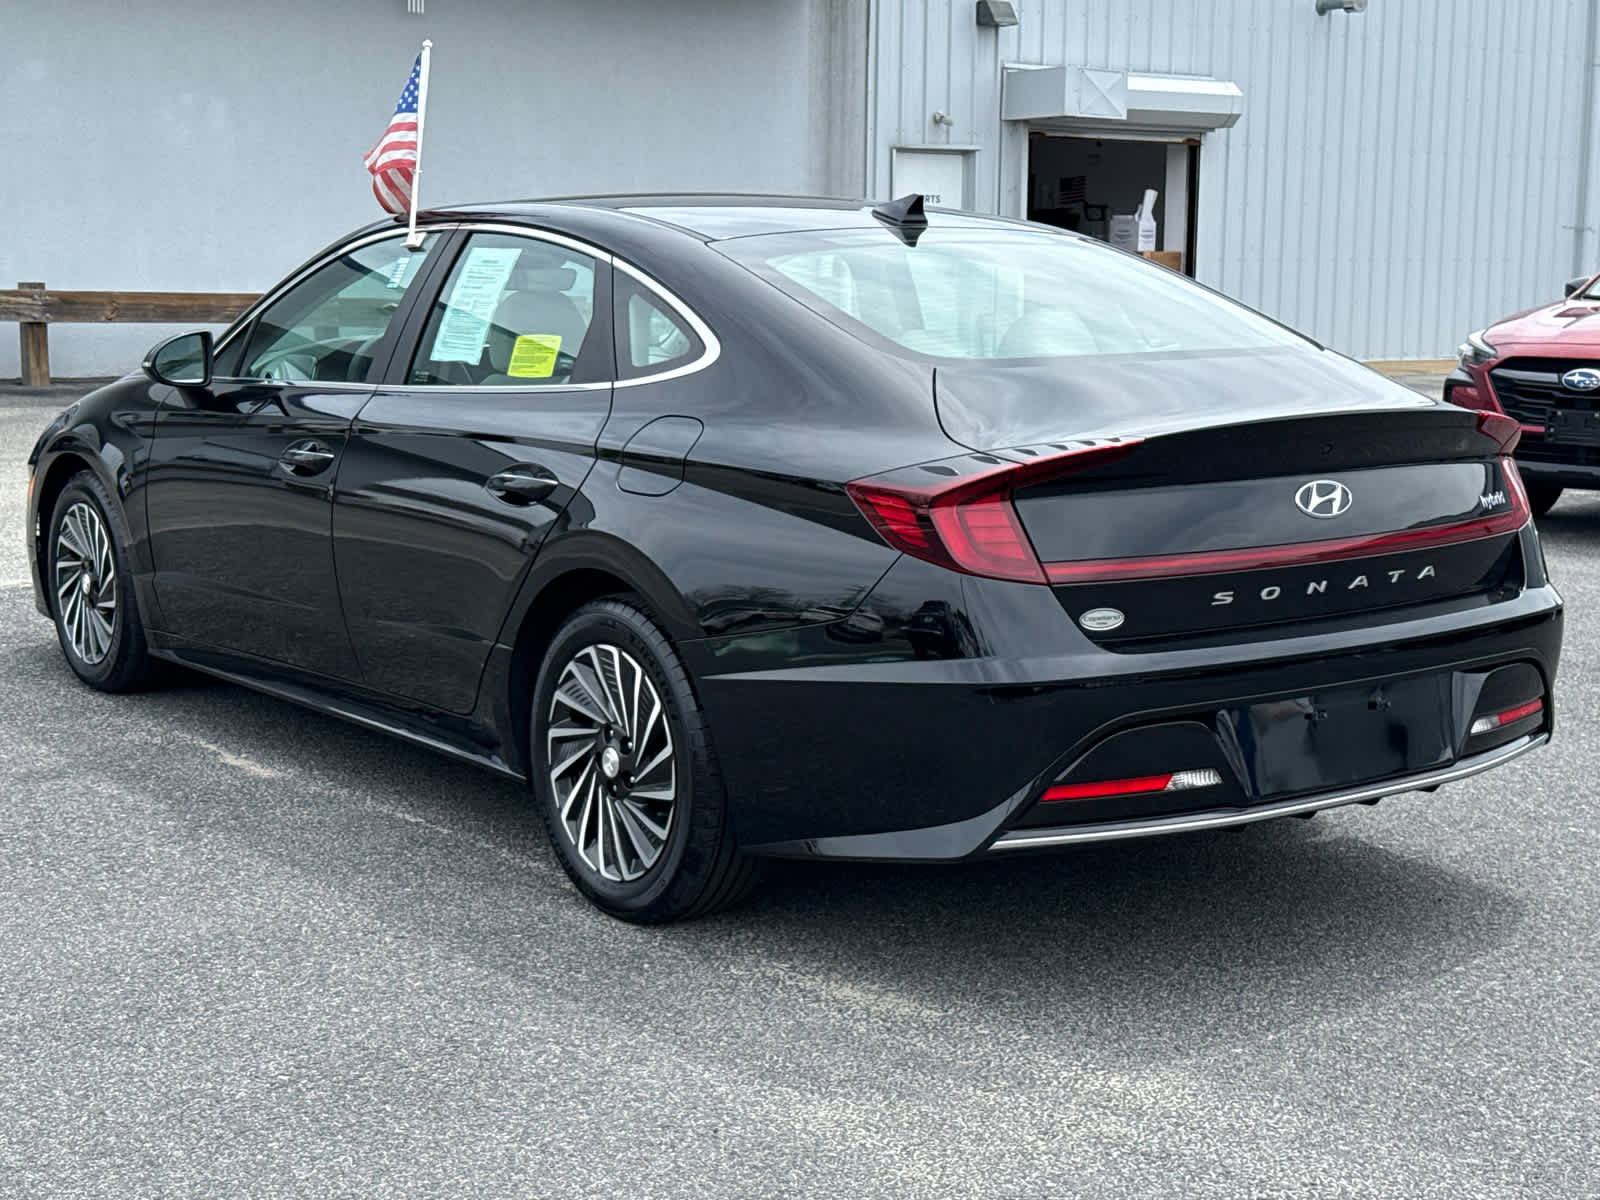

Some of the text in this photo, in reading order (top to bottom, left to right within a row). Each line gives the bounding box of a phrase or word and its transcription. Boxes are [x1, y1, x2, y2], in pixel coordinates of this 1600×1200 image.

[924, 194, 942, 204] RTS
[1480, 490, 1506, 510] hybrid
[1211, 565, 1436, 606] SONATA
